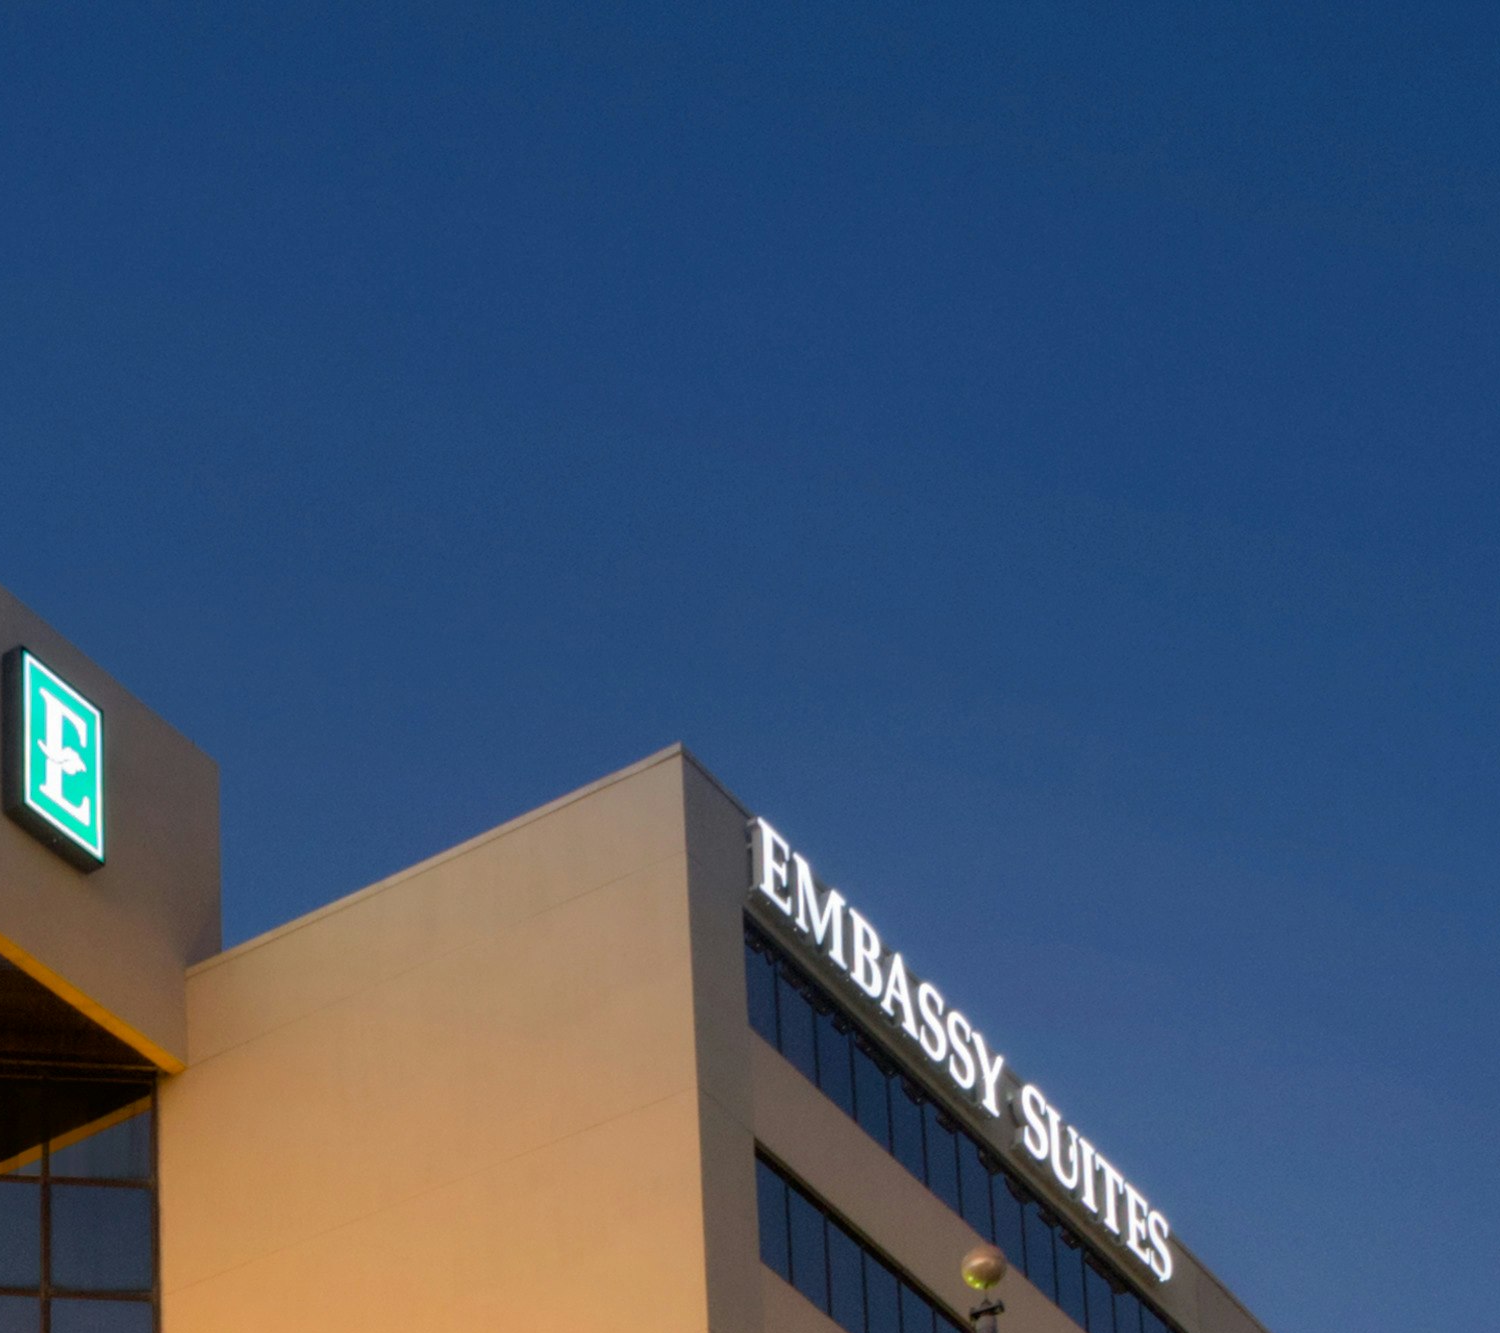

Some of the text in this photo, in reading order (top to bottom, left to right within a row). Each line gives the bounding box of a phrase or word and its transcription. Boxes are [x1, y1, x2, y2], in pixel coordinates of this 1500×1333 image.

[37, 686, 91, 828] E
[756, 816, 1173, 1283] EMBASSY SUITES
